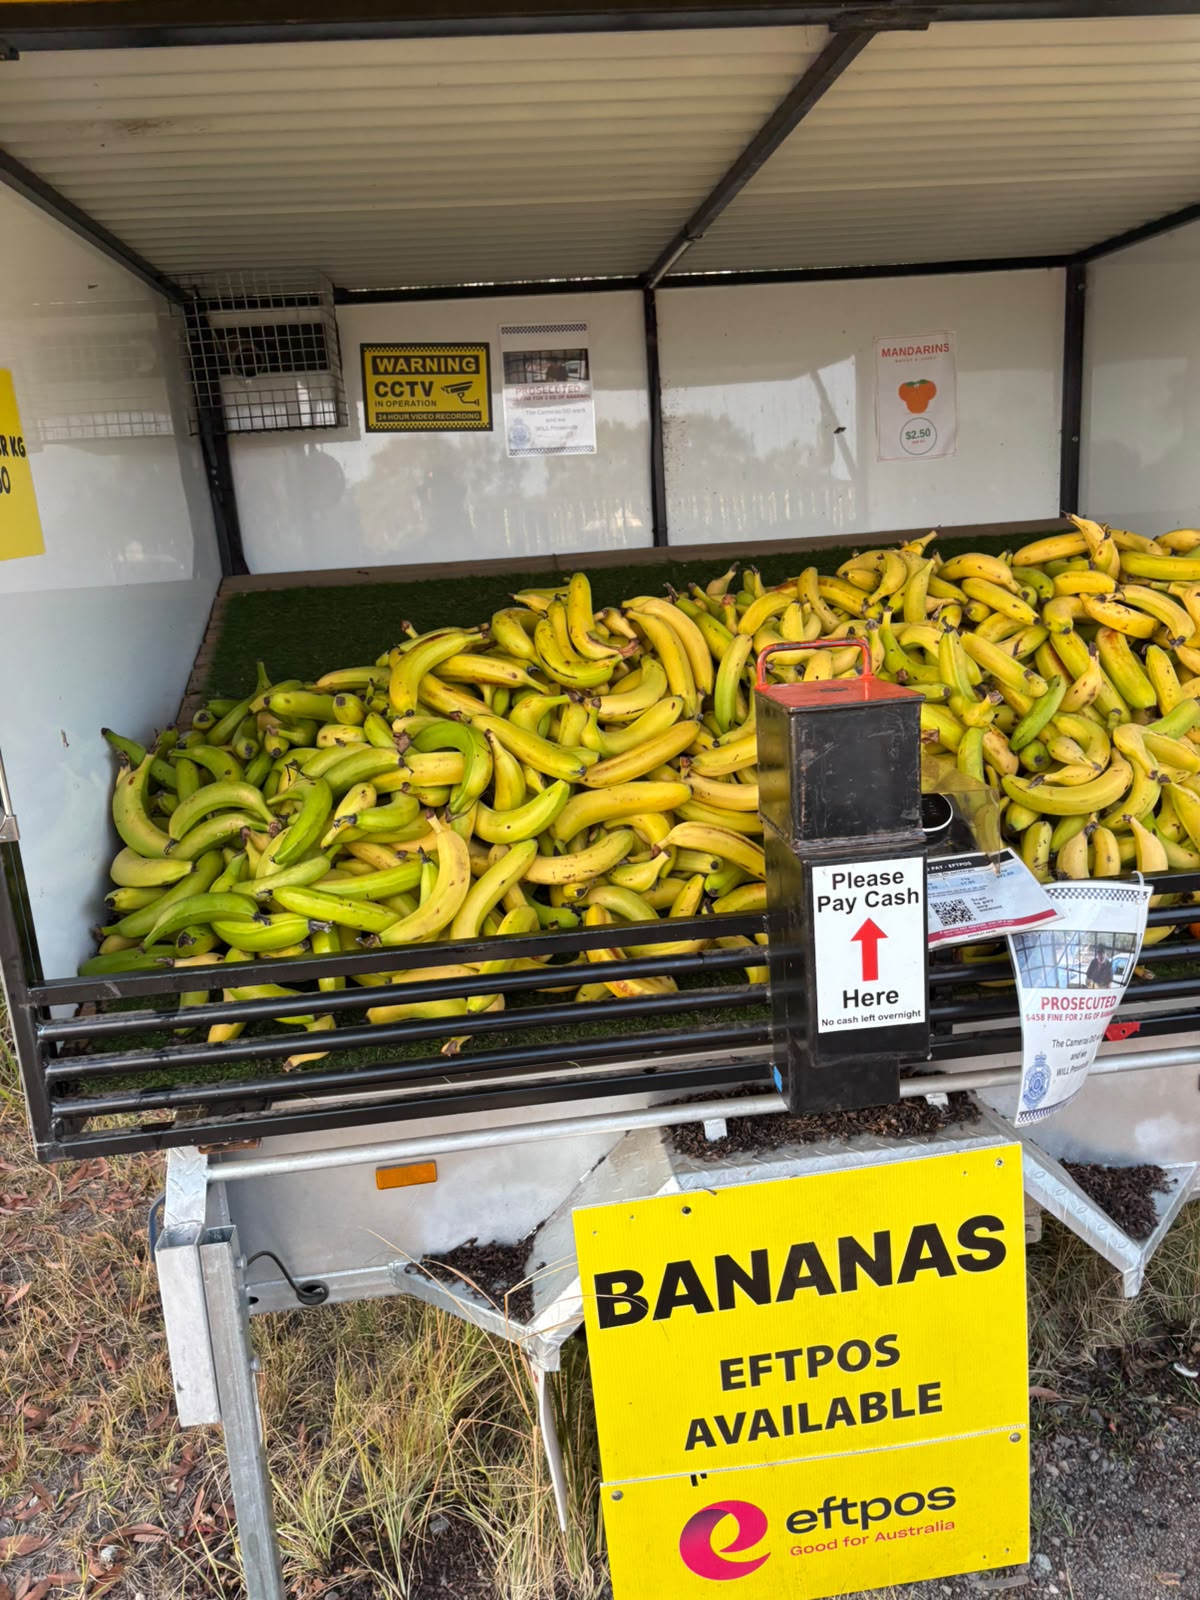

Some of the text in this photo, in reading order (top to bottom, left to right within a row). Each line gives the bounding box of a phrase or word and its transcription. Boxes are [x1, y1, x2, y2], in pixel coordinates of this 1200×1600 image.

[881, 343, 950, 358] MANDARINS
[375, 357, 476, 373] WARNING
[374, 381, 434, 398] CCTV
[515, 385, 582, 396] PROSECUTED
[435, 412, 480, 420] RECORDING
[905, 428, 931, 440] $2.50
[0, 435, 26, 458] R KG
[0, 465, 11, 494] 0
[831, 870, 905, 890] Please
[817, 895, 857, 915] Pay
[864, 887, 920, 908] Cash
[842, 988, 899, 1009] Here
[1041, 995, 1117, 1011] PROSECUTED
[821, 1010, 922, 1027] No cash left overnight
[1047, 1013, 1063, 1022] FINE
[1065, 1013, 1078, 1021] FOR
[1079, 1012, 1083, 1021] 2
[1084, 1012, 1092, 1020] KG
[1093, 1011, 1100, 1019] OF
[1052, 1039, 1064, 1048] The
[1066, 1037, 1089, 1047] Cameras
[1070, 1051, 1081, 1060] and
[1056, 1067, 1071, 1076] WILL
[593, 1214, 1007, 1330] BANANAS
[720, 1333, 901, 1391] EFTPOS
[684, 1381, 943, 1451] AVAILABLE
[786, 1486, 957, 1535] eftpos
[790, 1520, 955, 1556] Good for Australia
